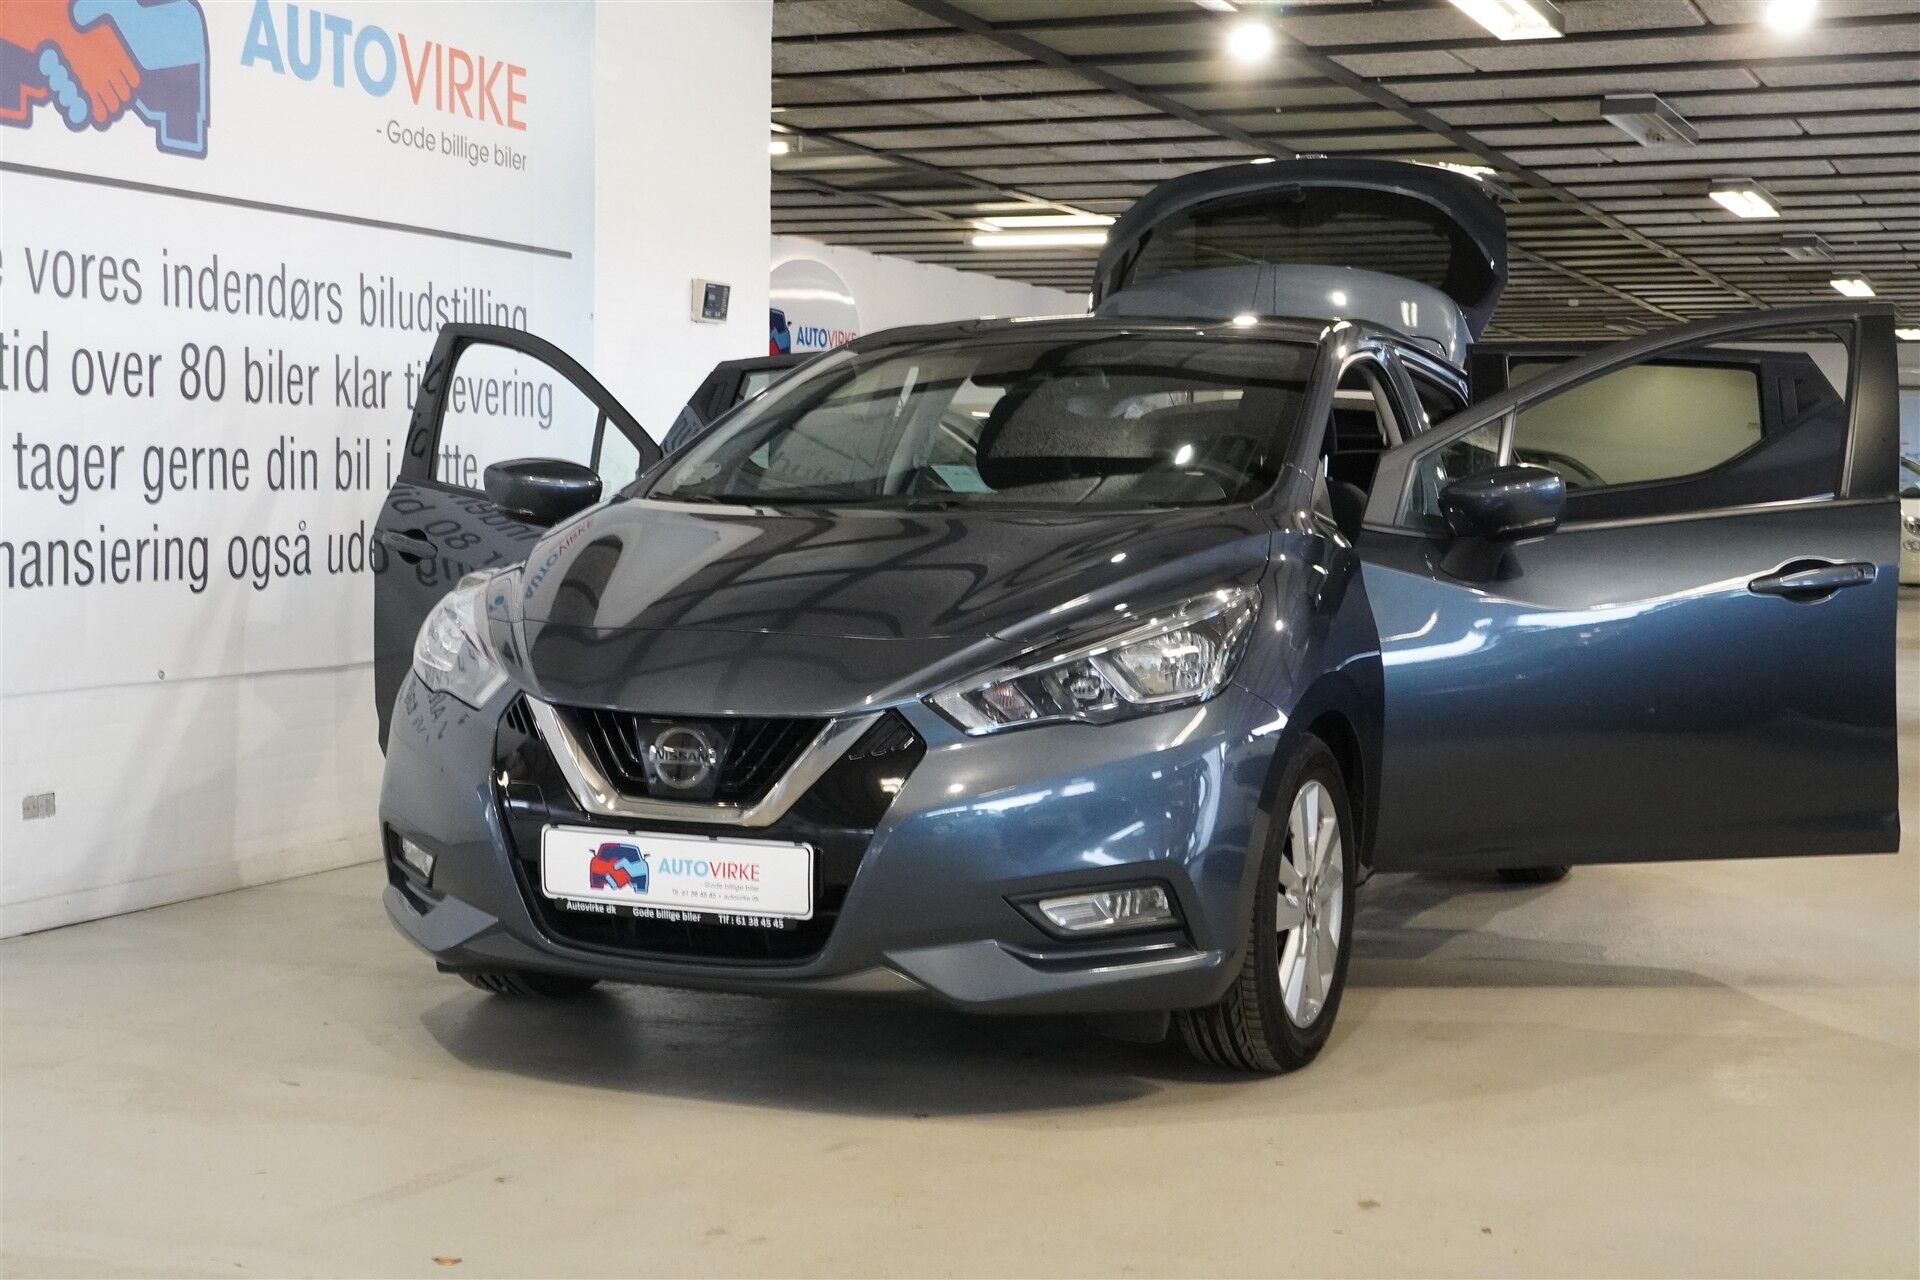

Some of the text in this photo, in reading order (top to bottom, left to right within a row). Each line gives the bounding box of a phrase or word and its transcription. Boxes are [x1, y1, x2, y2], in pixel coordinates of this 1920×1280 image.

[240, 0, 528, 132] AUTOVIRKE
[387, 119, 436, 152] Gode
[441, 131, 490, 167] billige
[494, 143, 528, 171] biler
[24, 247, 143, 305] vores
[162, 247, 343, 321] indendørs
[71, 348, 162, 399] over
[180, 342, 226, 402] 80
[244, 346, 320, 405] biler
[335, 353, 392, 409] klar
[447, 368, 554, 430] evering
[12, 432, 125, 505] tager
[143, 440, 250, 503] gerne
[266, 435, 319, 492] din
[335, 437, 371, 491] bil
[386, 438, 391, 491] i
[228, 520, 312, 590] også
[655, 748, 709, 764] NISSAN
[658, 857, 759, 882] AUTOVIRKE
[566, 900, 604, 913] Autovirke
[632, 906, 655, 919] Gode
[656, 908, 681, 922] billige
[682, 910, 701, 922] biler
[735, 915, 747, 926] 61
[748, 916, 759, 927] 38
[760, 917, 772, 928] 45
[773, 918, 784, 929] 45
